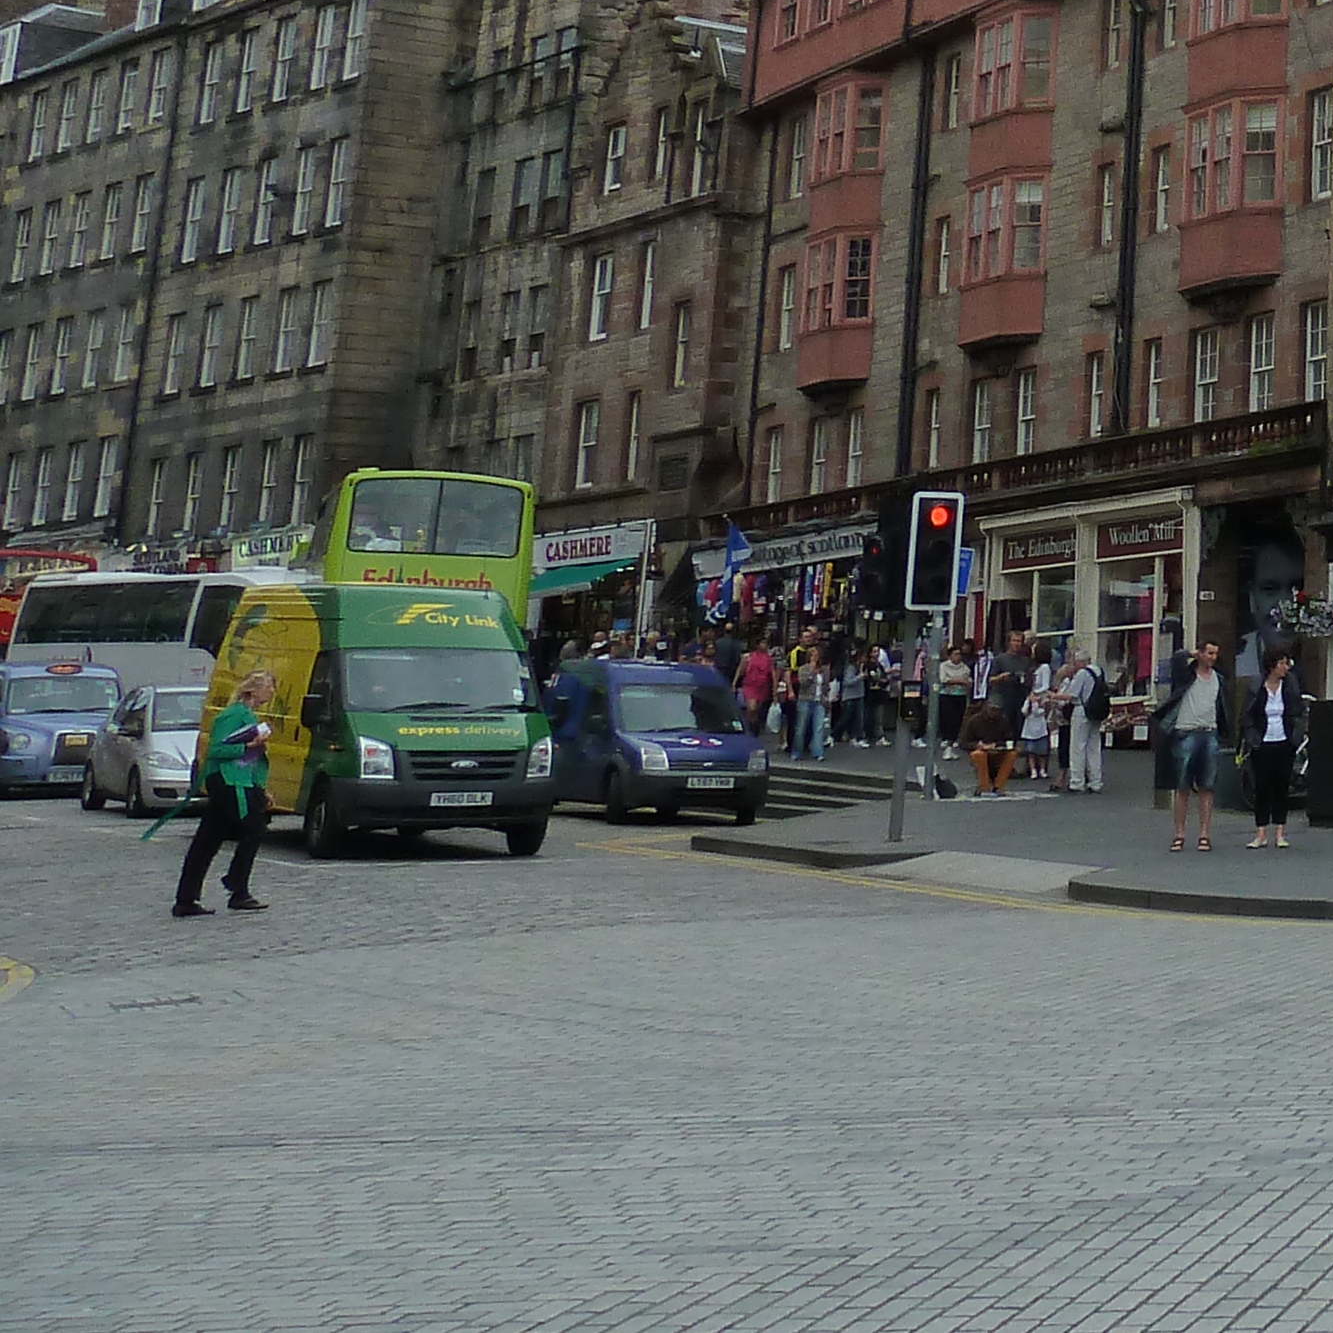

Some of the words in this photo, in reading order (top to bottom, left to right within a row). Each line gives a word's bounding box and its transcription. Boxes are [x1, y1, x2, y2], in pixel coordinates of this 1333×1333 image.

[1109, 525, 1150, 546] Woollen
[1150, 521, 1176, 541] Mill
[546, 535, 612, 562] CASHMERE
[1008, 541, 1026, 560] The
[1028, 533, 1076, 558] Edinburgh
[424, 613, 459, 628] City
[465, 615, 500, 629] Link
[398, 725, 461, 736] express
[464, 724, 521, 737] delivery
